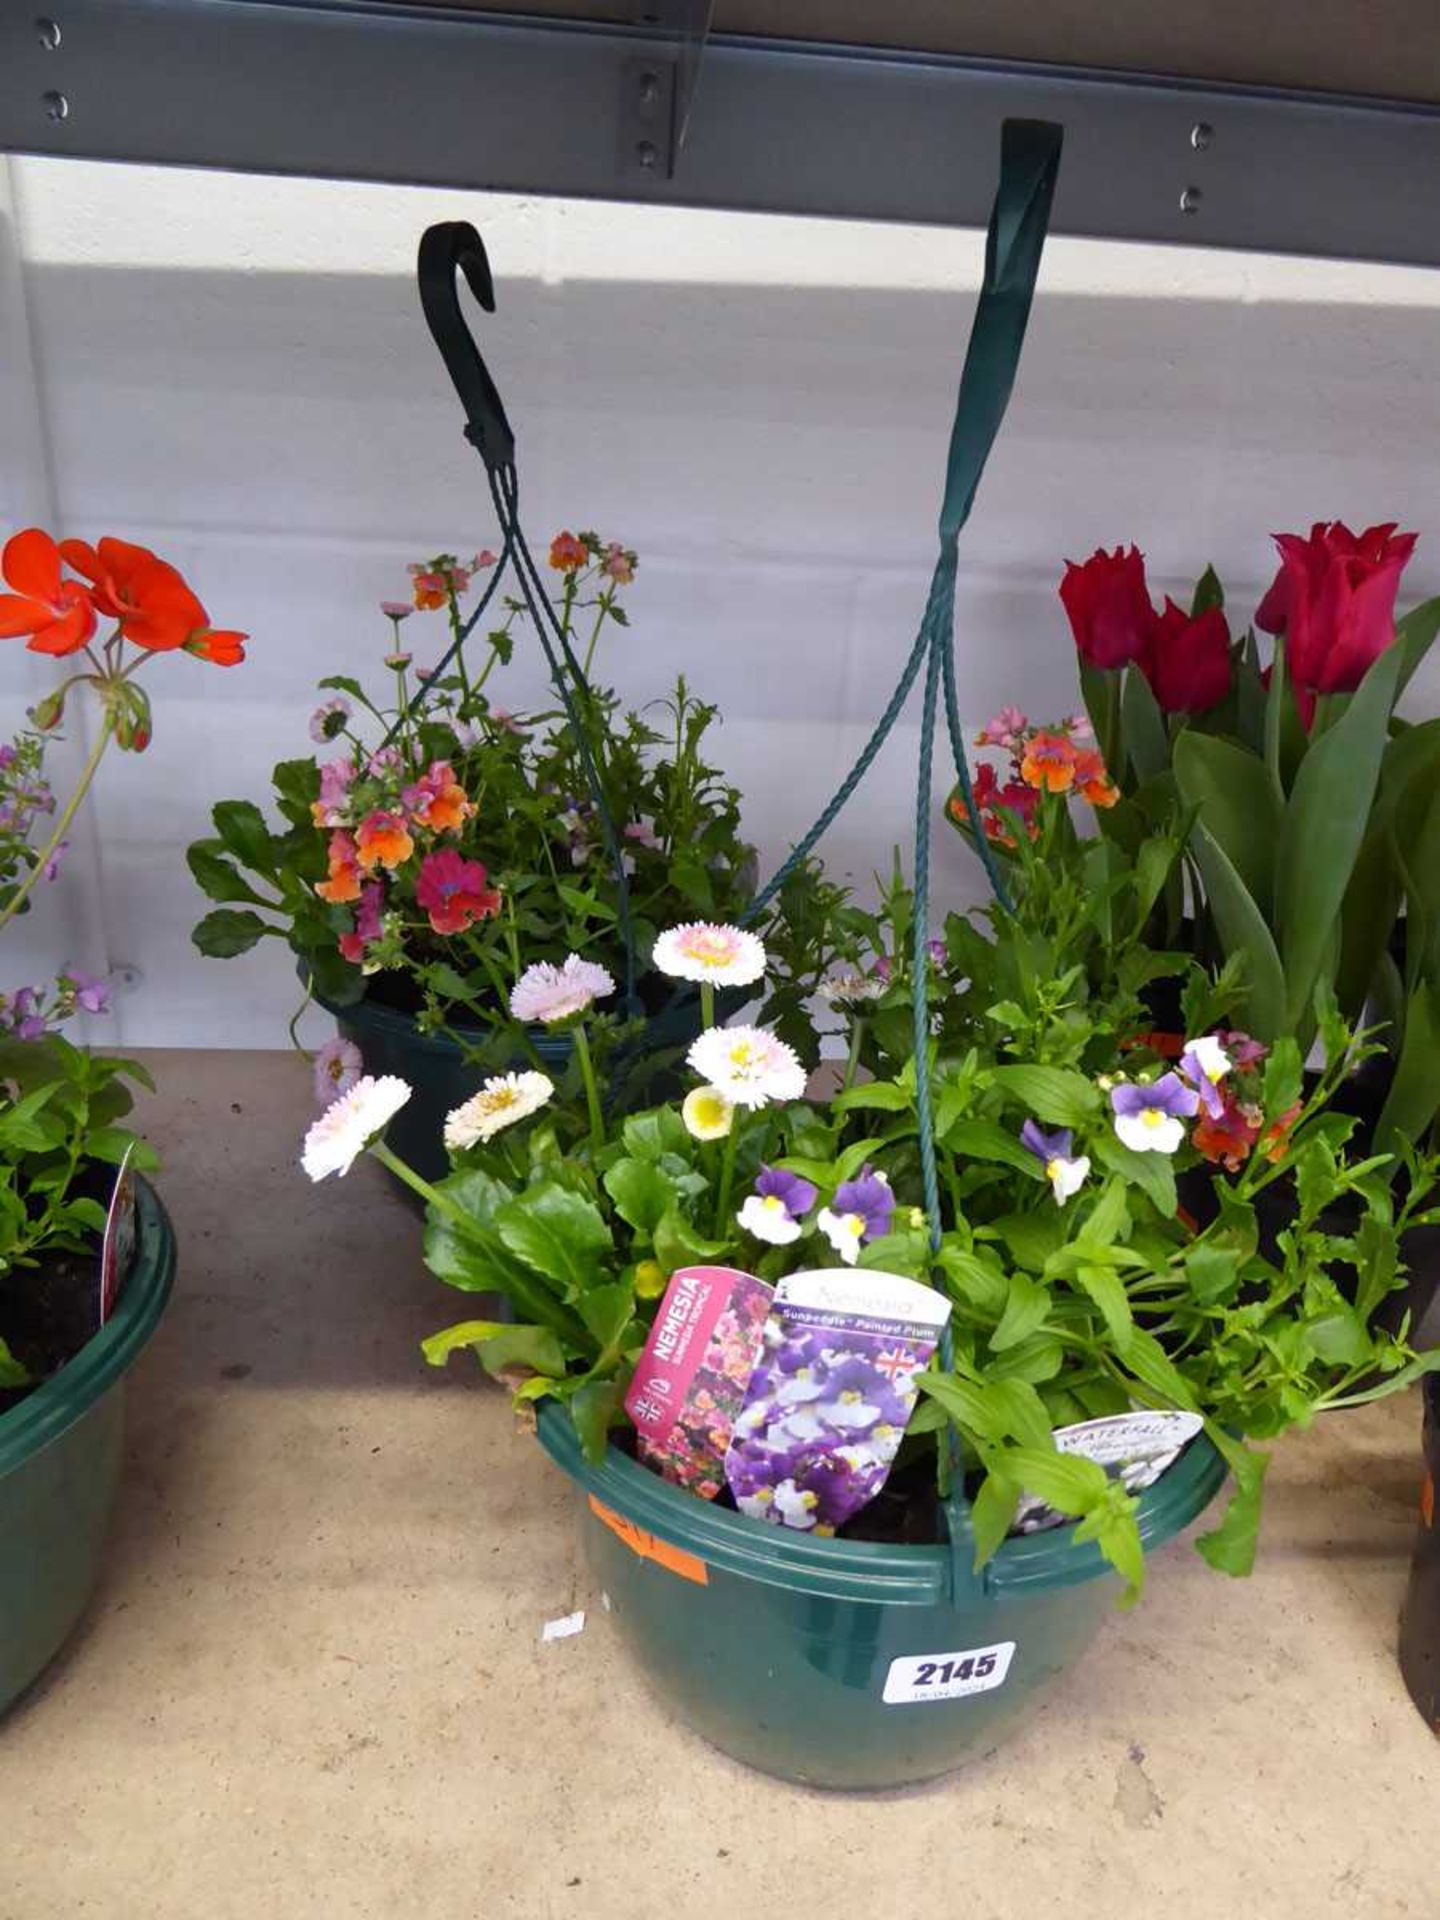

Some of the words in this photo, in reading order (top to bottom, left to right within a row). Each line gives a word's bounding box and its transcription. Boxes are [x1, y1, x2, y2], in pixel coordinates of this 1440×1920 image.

[652, 1277, 701, 1362] NEMESIA
[903, 1323, 936, 1338] Plum
[912, 1652, 998, 1686] 2145
